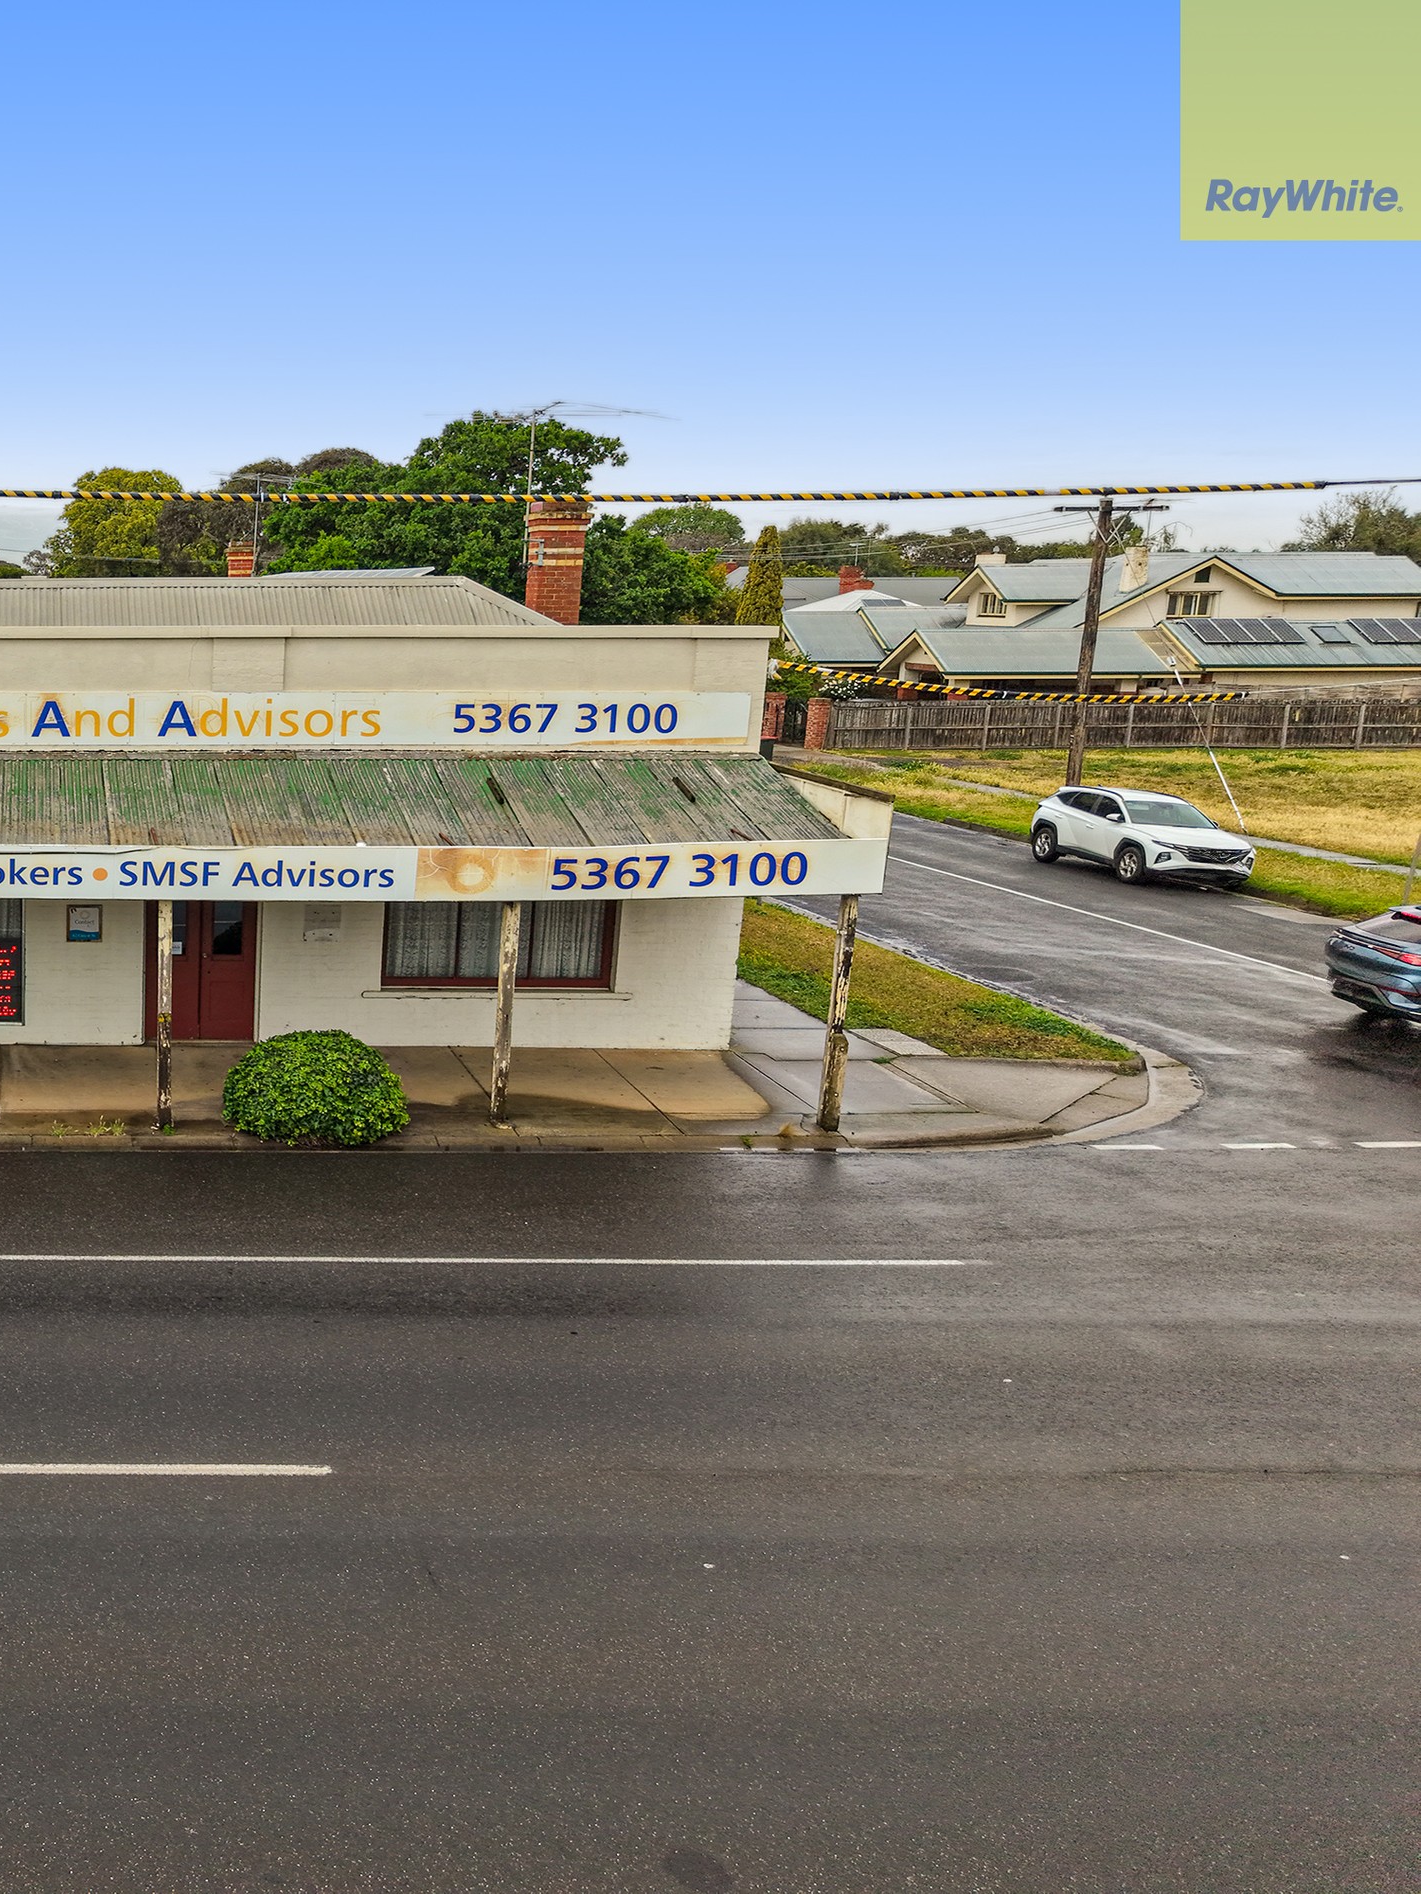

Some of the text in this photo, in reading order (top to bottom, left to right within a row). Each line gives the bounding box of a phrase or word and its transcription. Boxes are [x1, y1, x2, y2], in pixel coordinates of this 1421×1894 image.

[31, 698, 135, 737] And
[157, 698, 381, 738] Advisors
[453, 703, 559, 734] 5367
[574, 703, 678, 734] 3100
[119, 861, 221, 887] SMSF
[231, 860, 395, 888] Advisors
[551, 855, 670, 891] 5367
[689, 851, 809, 887] 3100
